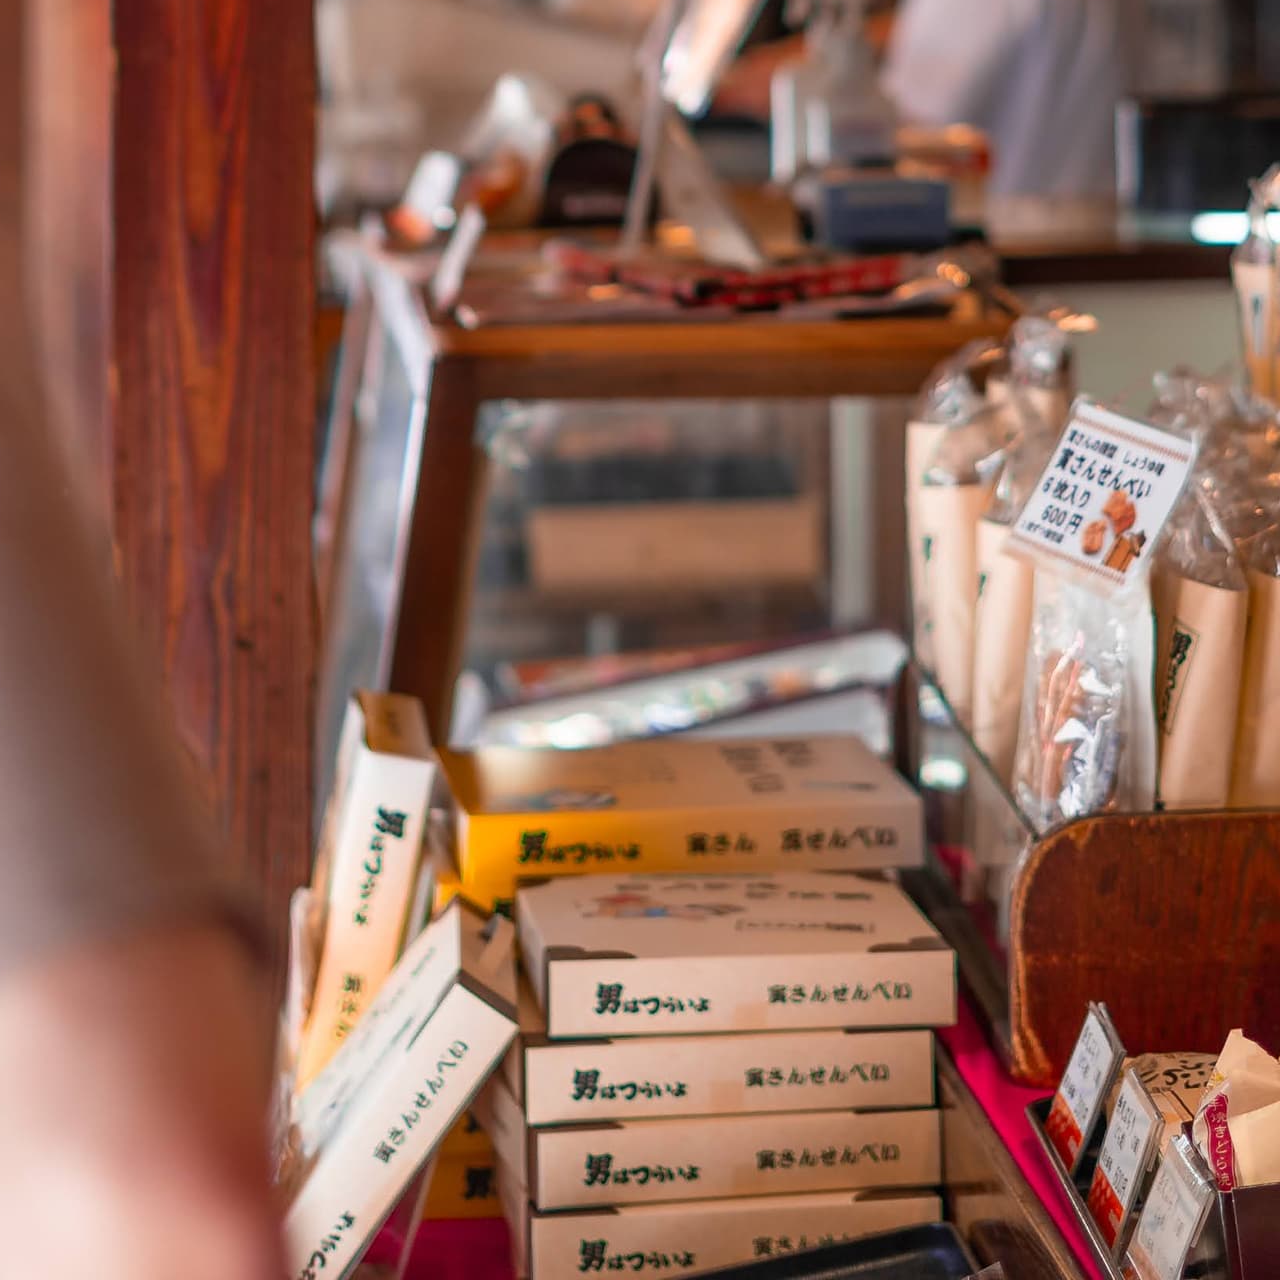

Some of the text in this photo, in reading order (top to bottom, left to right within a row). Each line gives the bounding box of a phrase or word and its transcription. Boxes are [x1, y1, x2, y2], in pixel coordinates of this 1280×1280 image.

[1055, 447, 1152, 500] 寅さんせんべい
[518, 830, 641, 864] 男はつらいよ
[686, 831, 757, 857] 寅さん
[594, 978, 914, 1016] 男はつらいよ 寅さんせんべい
[372, 1039, 470, 1165] 寅さんせんべい
[570, 1061, 891, 1102] 男はつらいよ 寅さんせんべい
[583, 1142, 901, 1187] 男はつらいよ 寅さんせんべい
[577, 1238, 696, 1273] 男はつらいよ
